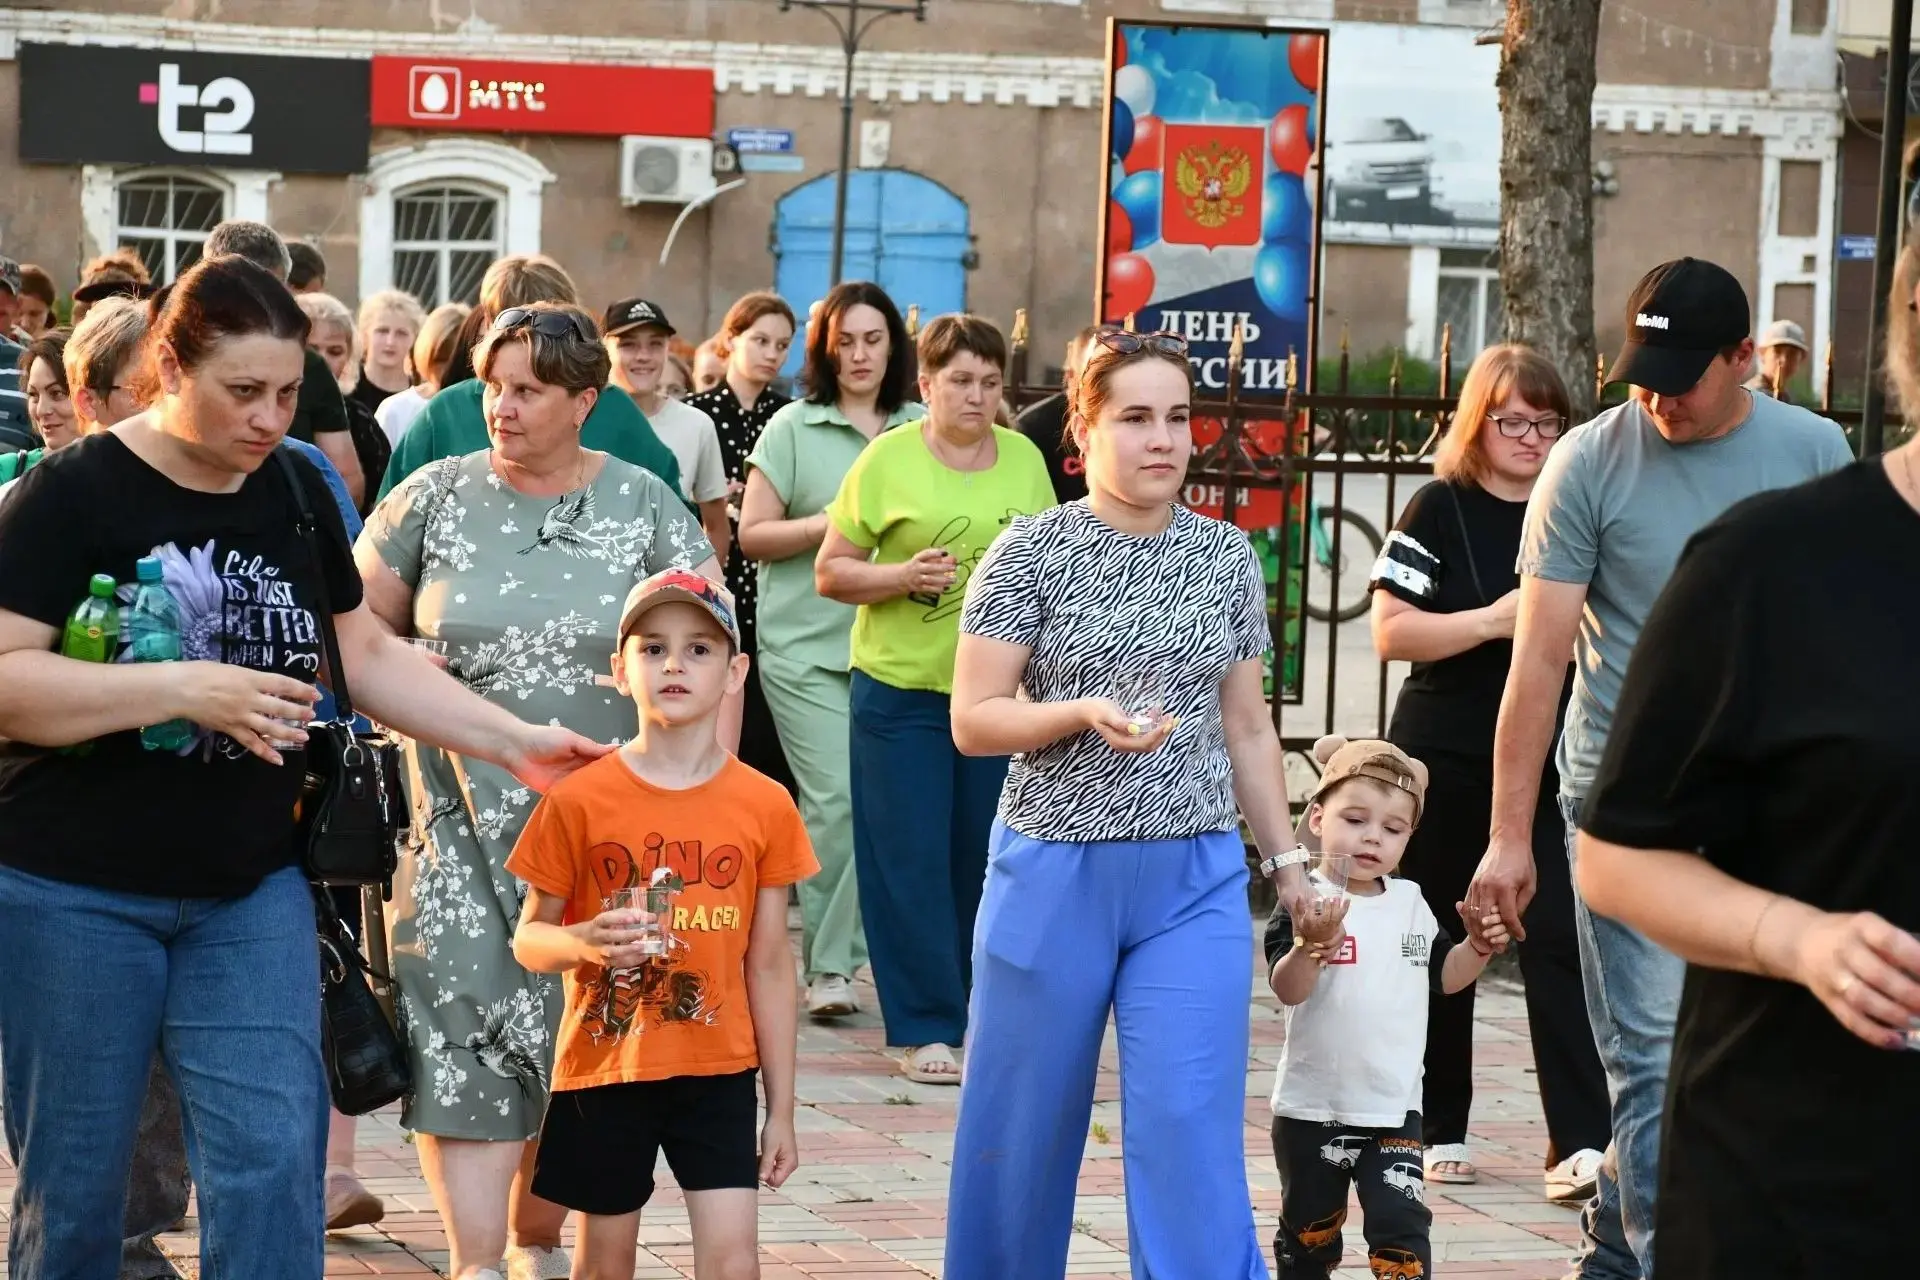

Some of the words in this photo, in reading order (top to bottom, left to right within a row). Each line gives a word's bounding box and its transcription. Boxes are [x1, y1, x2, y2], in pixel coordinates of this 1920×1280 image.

[158, 63, 255, 155] t2
[468, 79, 546, 112] МТС
[1635, 313, 1670, 330] MoMA
[222, 550, 280, 582] Life
[222, 577, 249, 601] IS
[252, 579, 296, 607] JUST
[225, 603, 319, 644] BETTER
[227, 644, 274, 667] WHEN
[672, 904, 741, 932] RACER
